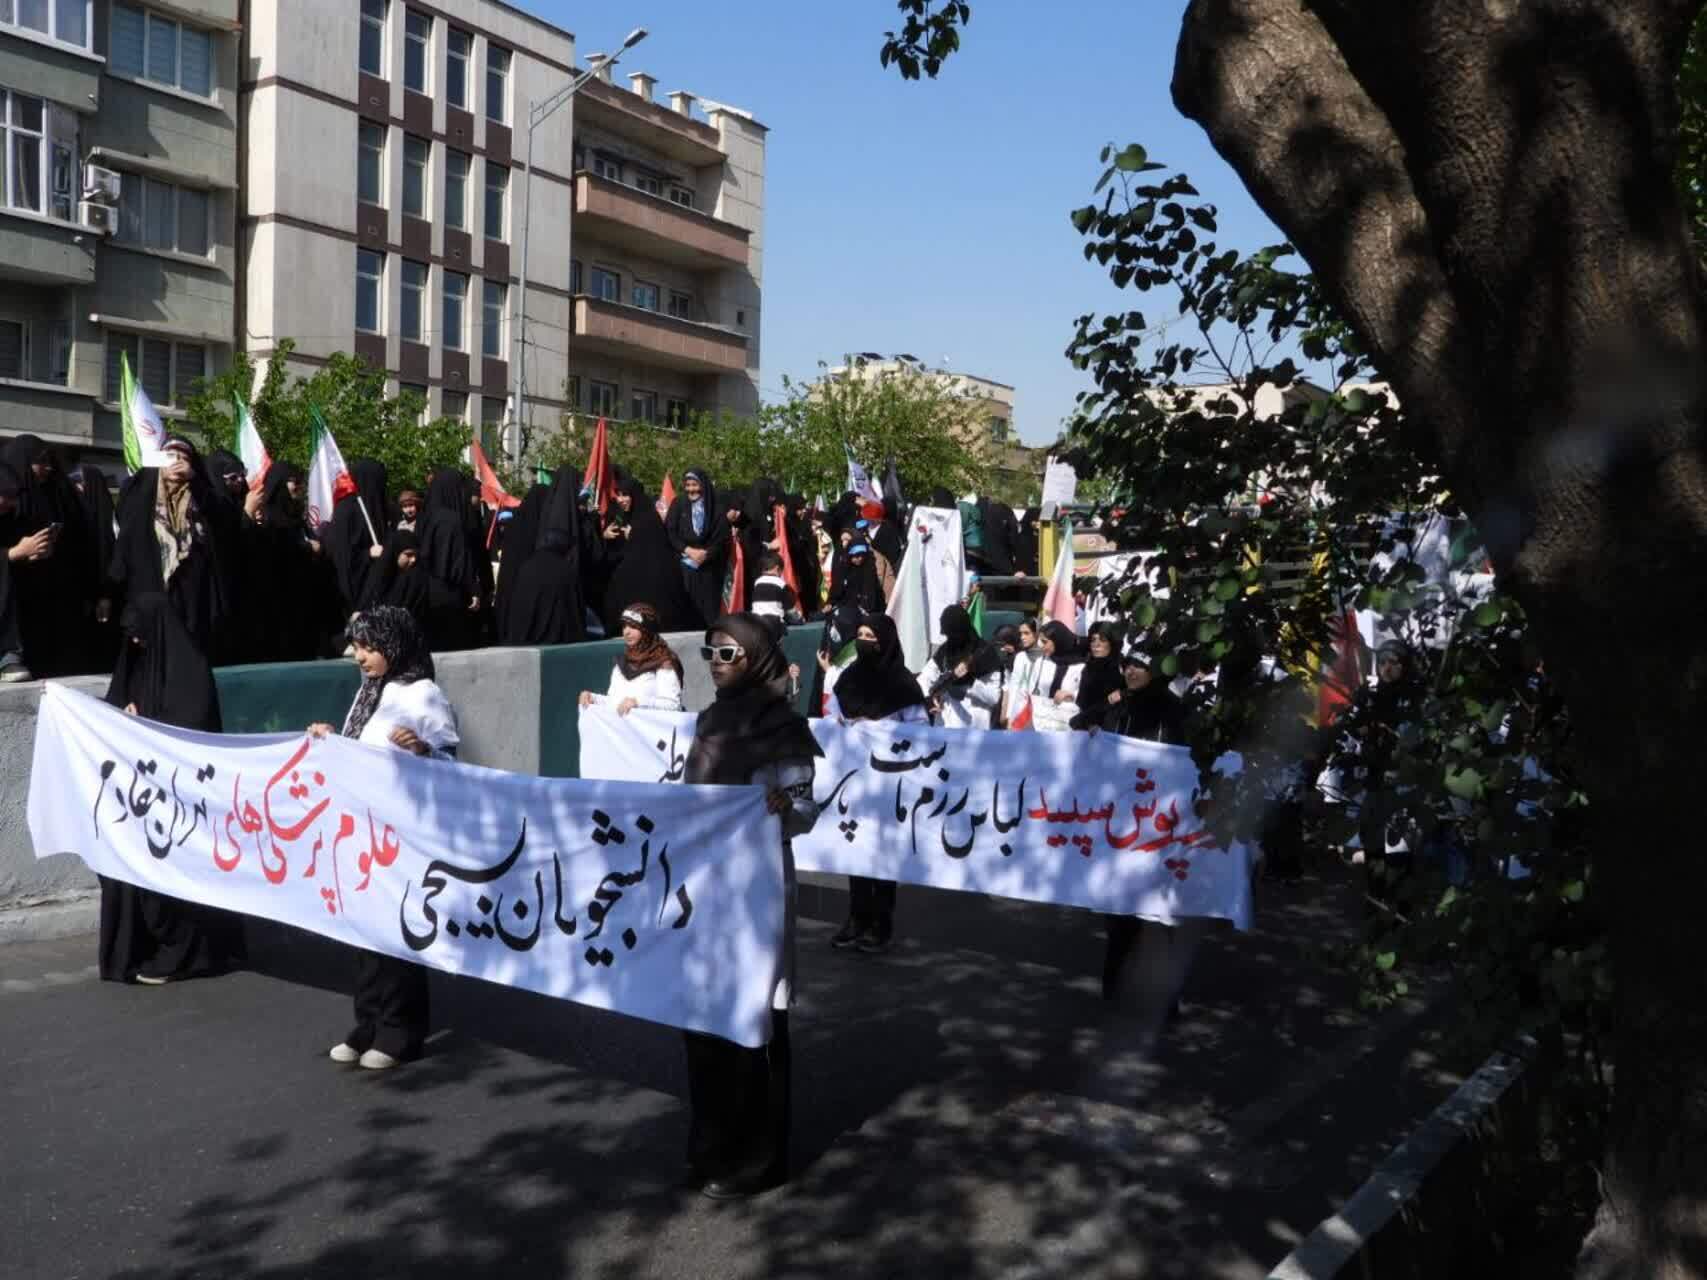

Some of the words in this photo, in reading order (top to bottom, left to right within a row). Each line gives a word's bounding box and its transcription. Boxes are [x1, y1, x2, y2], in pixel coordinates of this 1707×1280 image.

[333, 808, 401, 913] علوم
[912, 768, 968, 855] رزم
[942, 777, 1026, 859] لباس
[400, 817, 527, 951] بسیجی
[495, 809, 692, 967] دانشجویان
